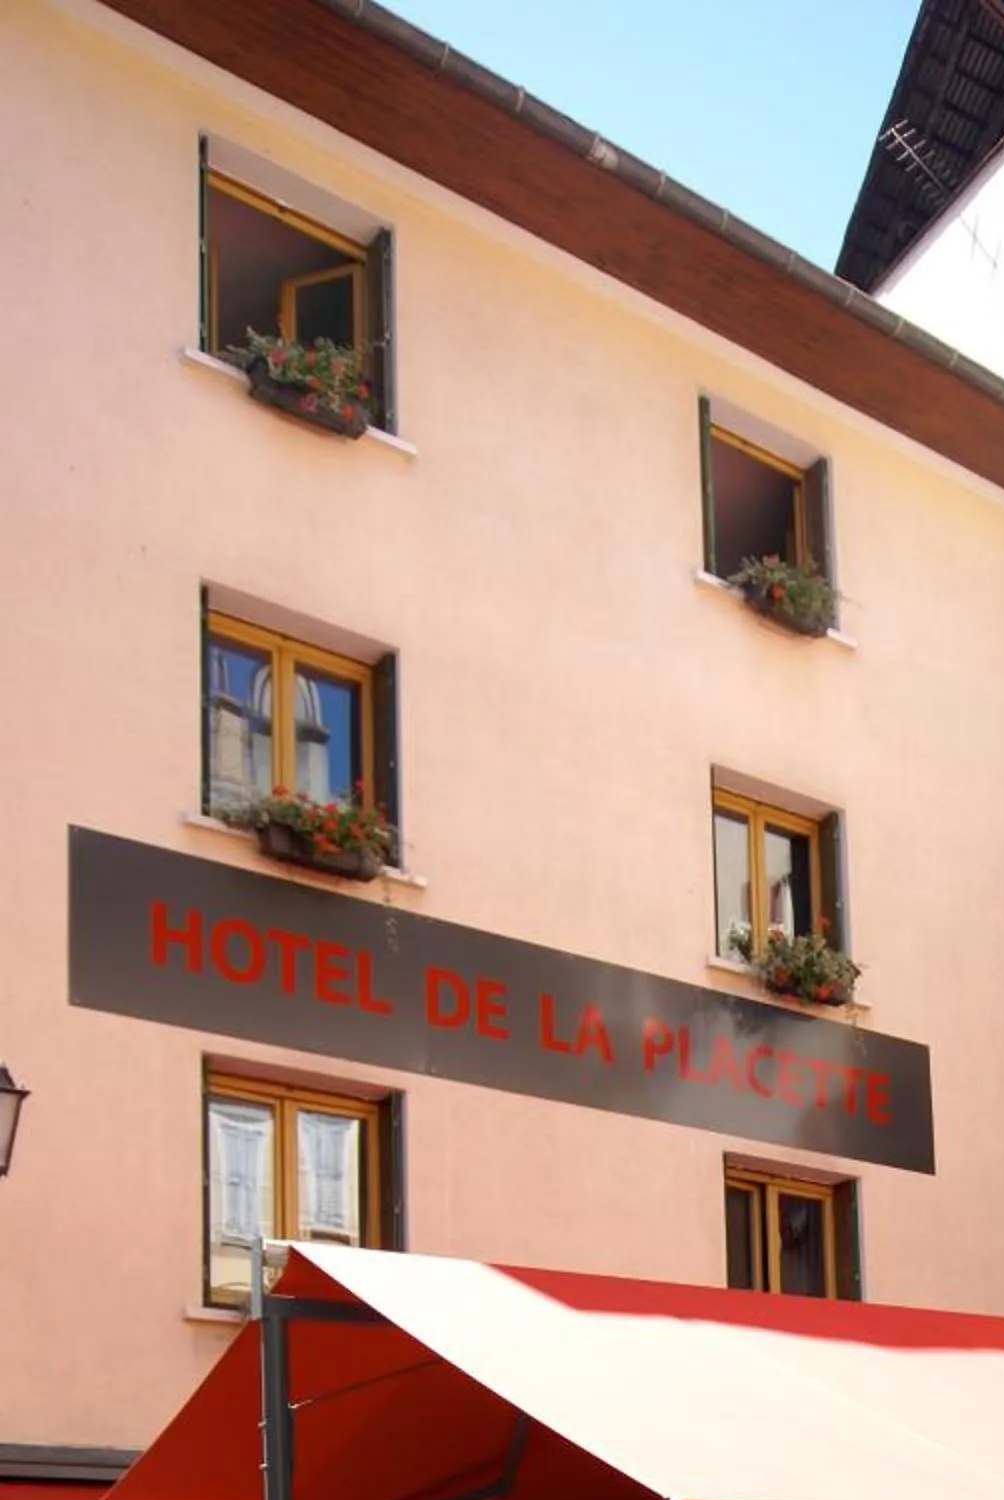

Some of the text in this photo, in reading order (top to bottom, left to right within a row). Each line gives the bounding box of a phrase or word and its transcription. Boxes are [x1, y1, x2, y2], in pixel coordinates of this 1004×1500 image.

[149, 899, 894, 1127] HOTEL DE LA PLACETTE
